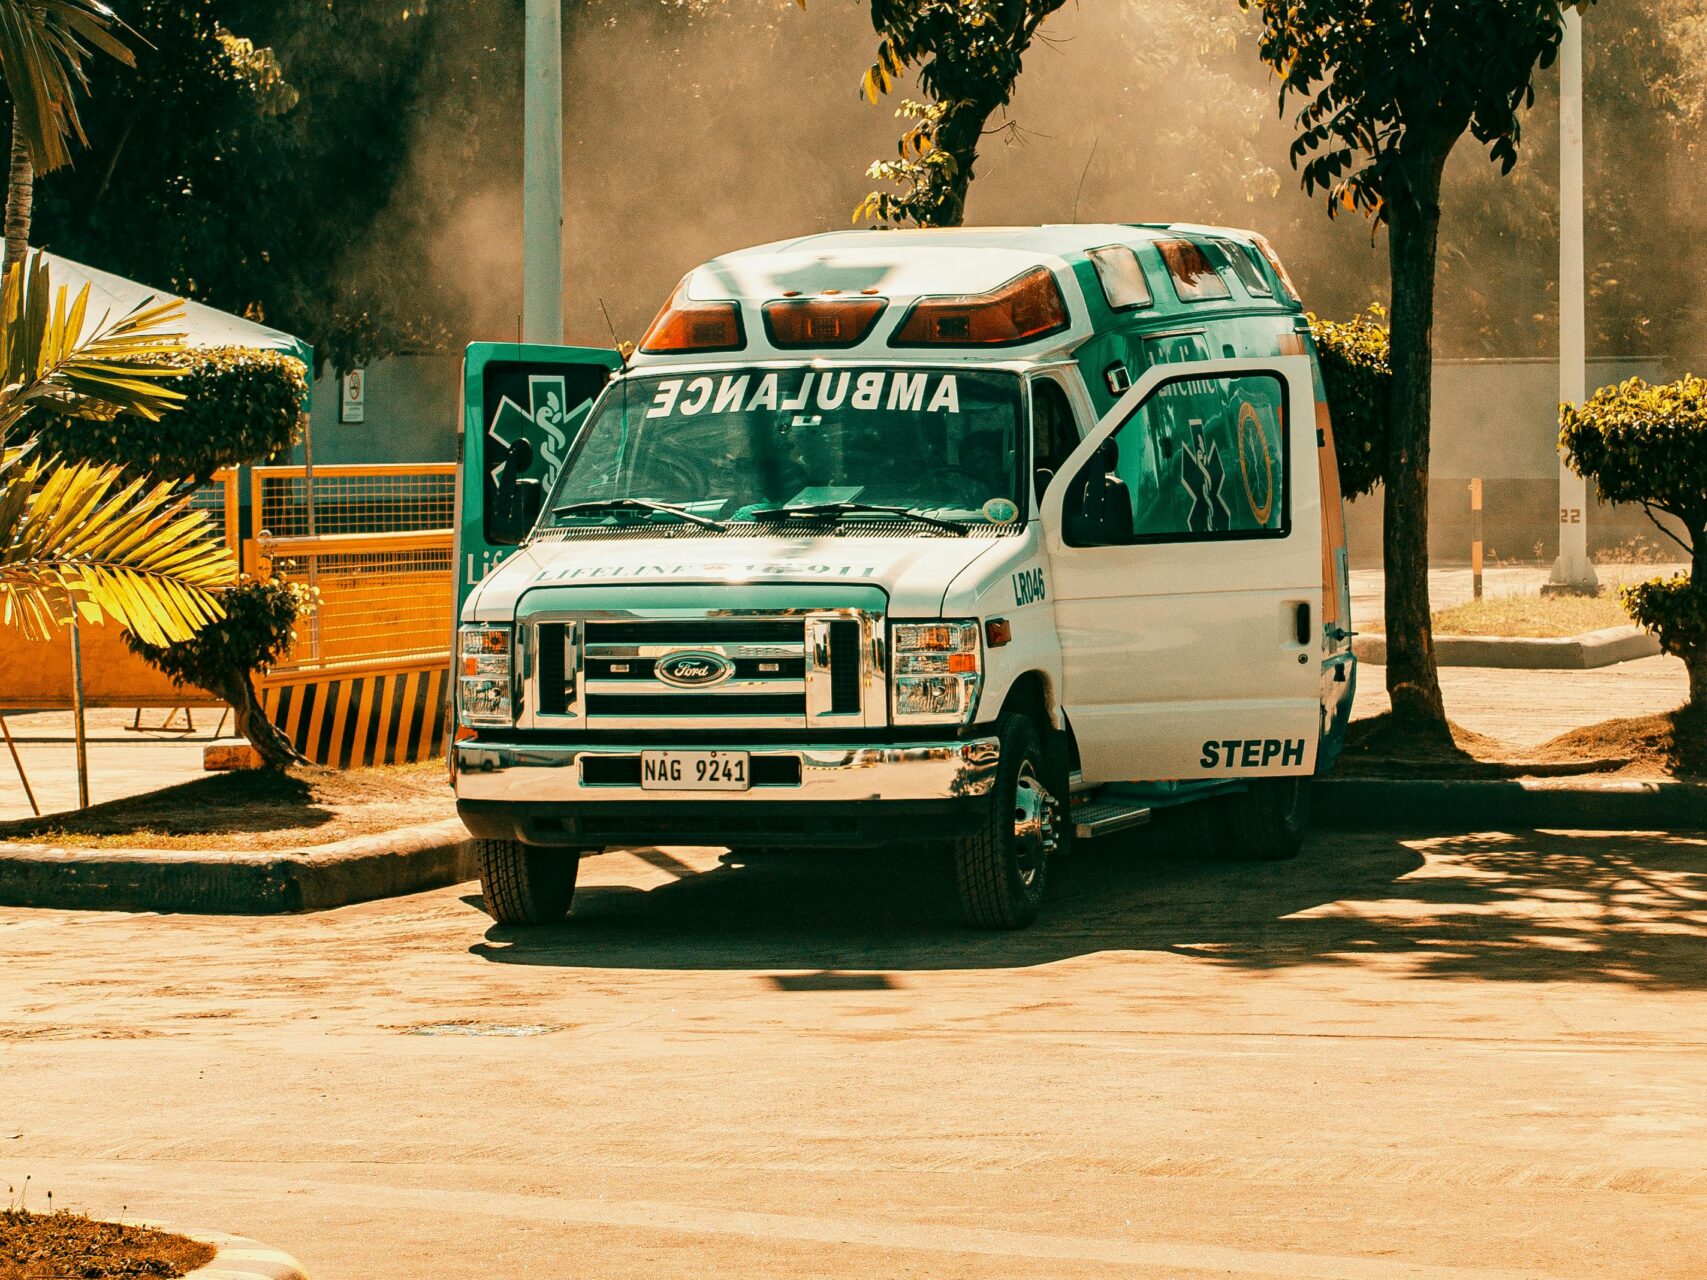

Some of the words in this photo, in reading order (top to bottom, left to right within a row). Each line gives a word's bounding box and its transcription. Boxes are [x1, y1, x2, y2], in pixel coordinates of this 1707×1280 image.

[1560, 509, 1580, 523] 22
[467, 550, 503, 585] Lif
[535, 564, 695, 582] LIFELINE
[1012, 567, 1046, 607] LR046
[674, 661, 709, 677] Ford
[1199, 739, 1305, 769] STEPH
[644, 759, 682, 782] NAG
[696, 759, 745, 782] 9241
